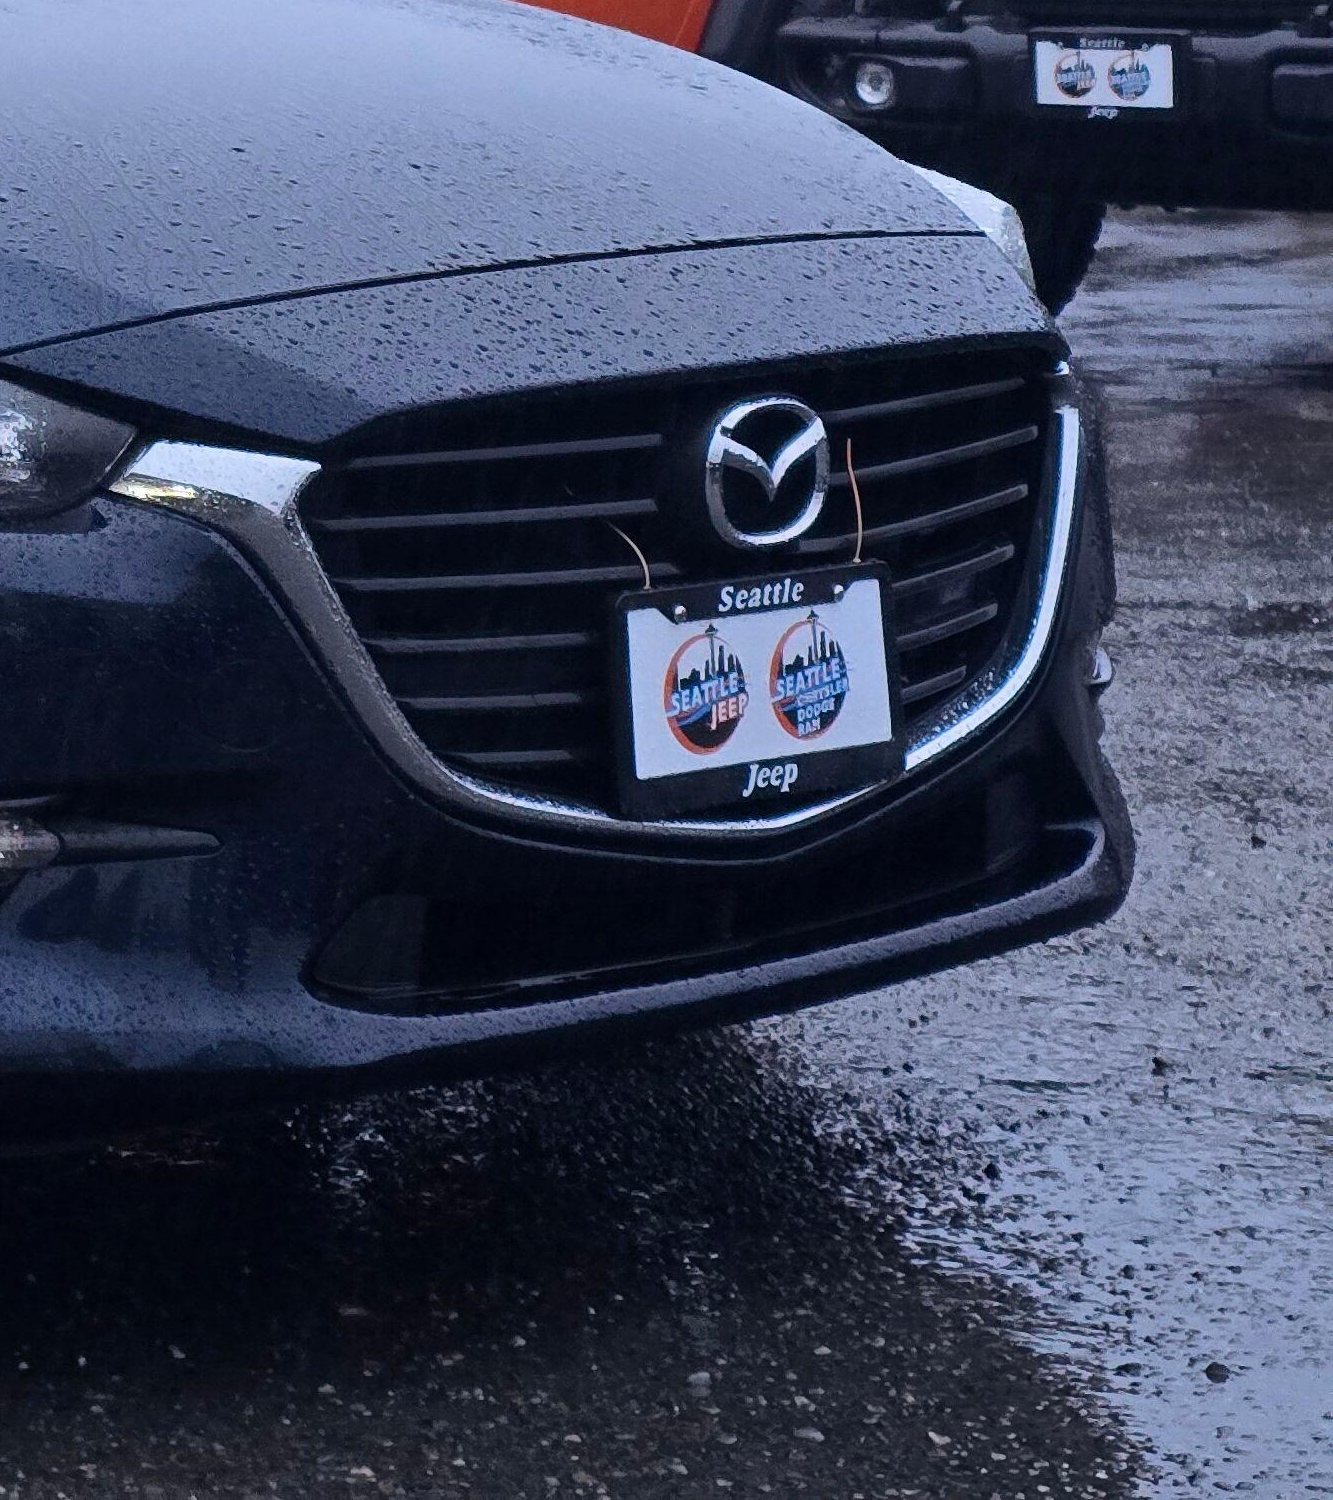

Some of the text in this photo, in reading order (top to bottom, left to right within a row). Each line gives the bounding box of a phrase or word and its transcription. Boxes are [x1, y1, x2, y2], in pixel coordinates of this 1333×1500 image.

[718, 578, 804, 612] Seattle
[667, 671, 739, 717] SEATTLE
[773, 657, 841, 699] SEATTLE
[710, 692, 749, 730] JEEP
[742, 763, 798, 797] Jeep
